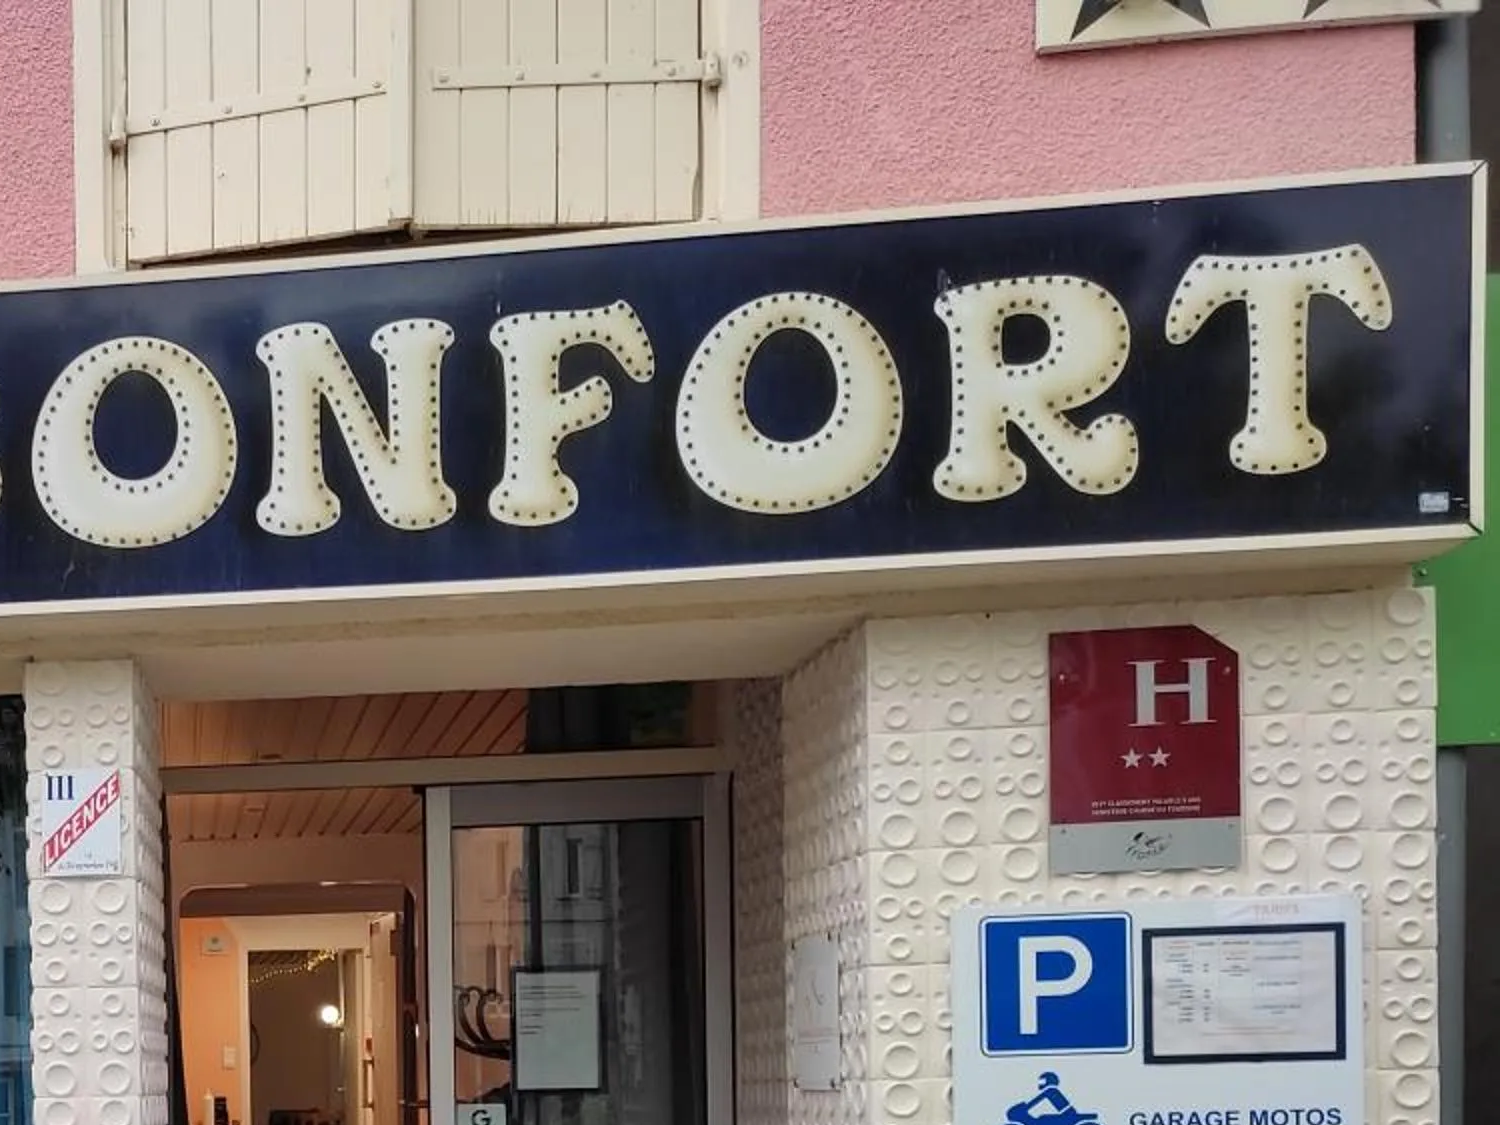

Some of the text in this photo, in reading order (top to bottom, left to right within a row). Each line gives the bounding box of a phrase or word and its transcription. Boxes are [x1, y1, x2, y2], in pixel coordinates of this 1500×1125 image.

[1126, 657, 1217, 726] H
[44, 772, 119, 868] LICENCE
[47, 775, 73, 800] III
[1018, 935, 1093, 1035] P
